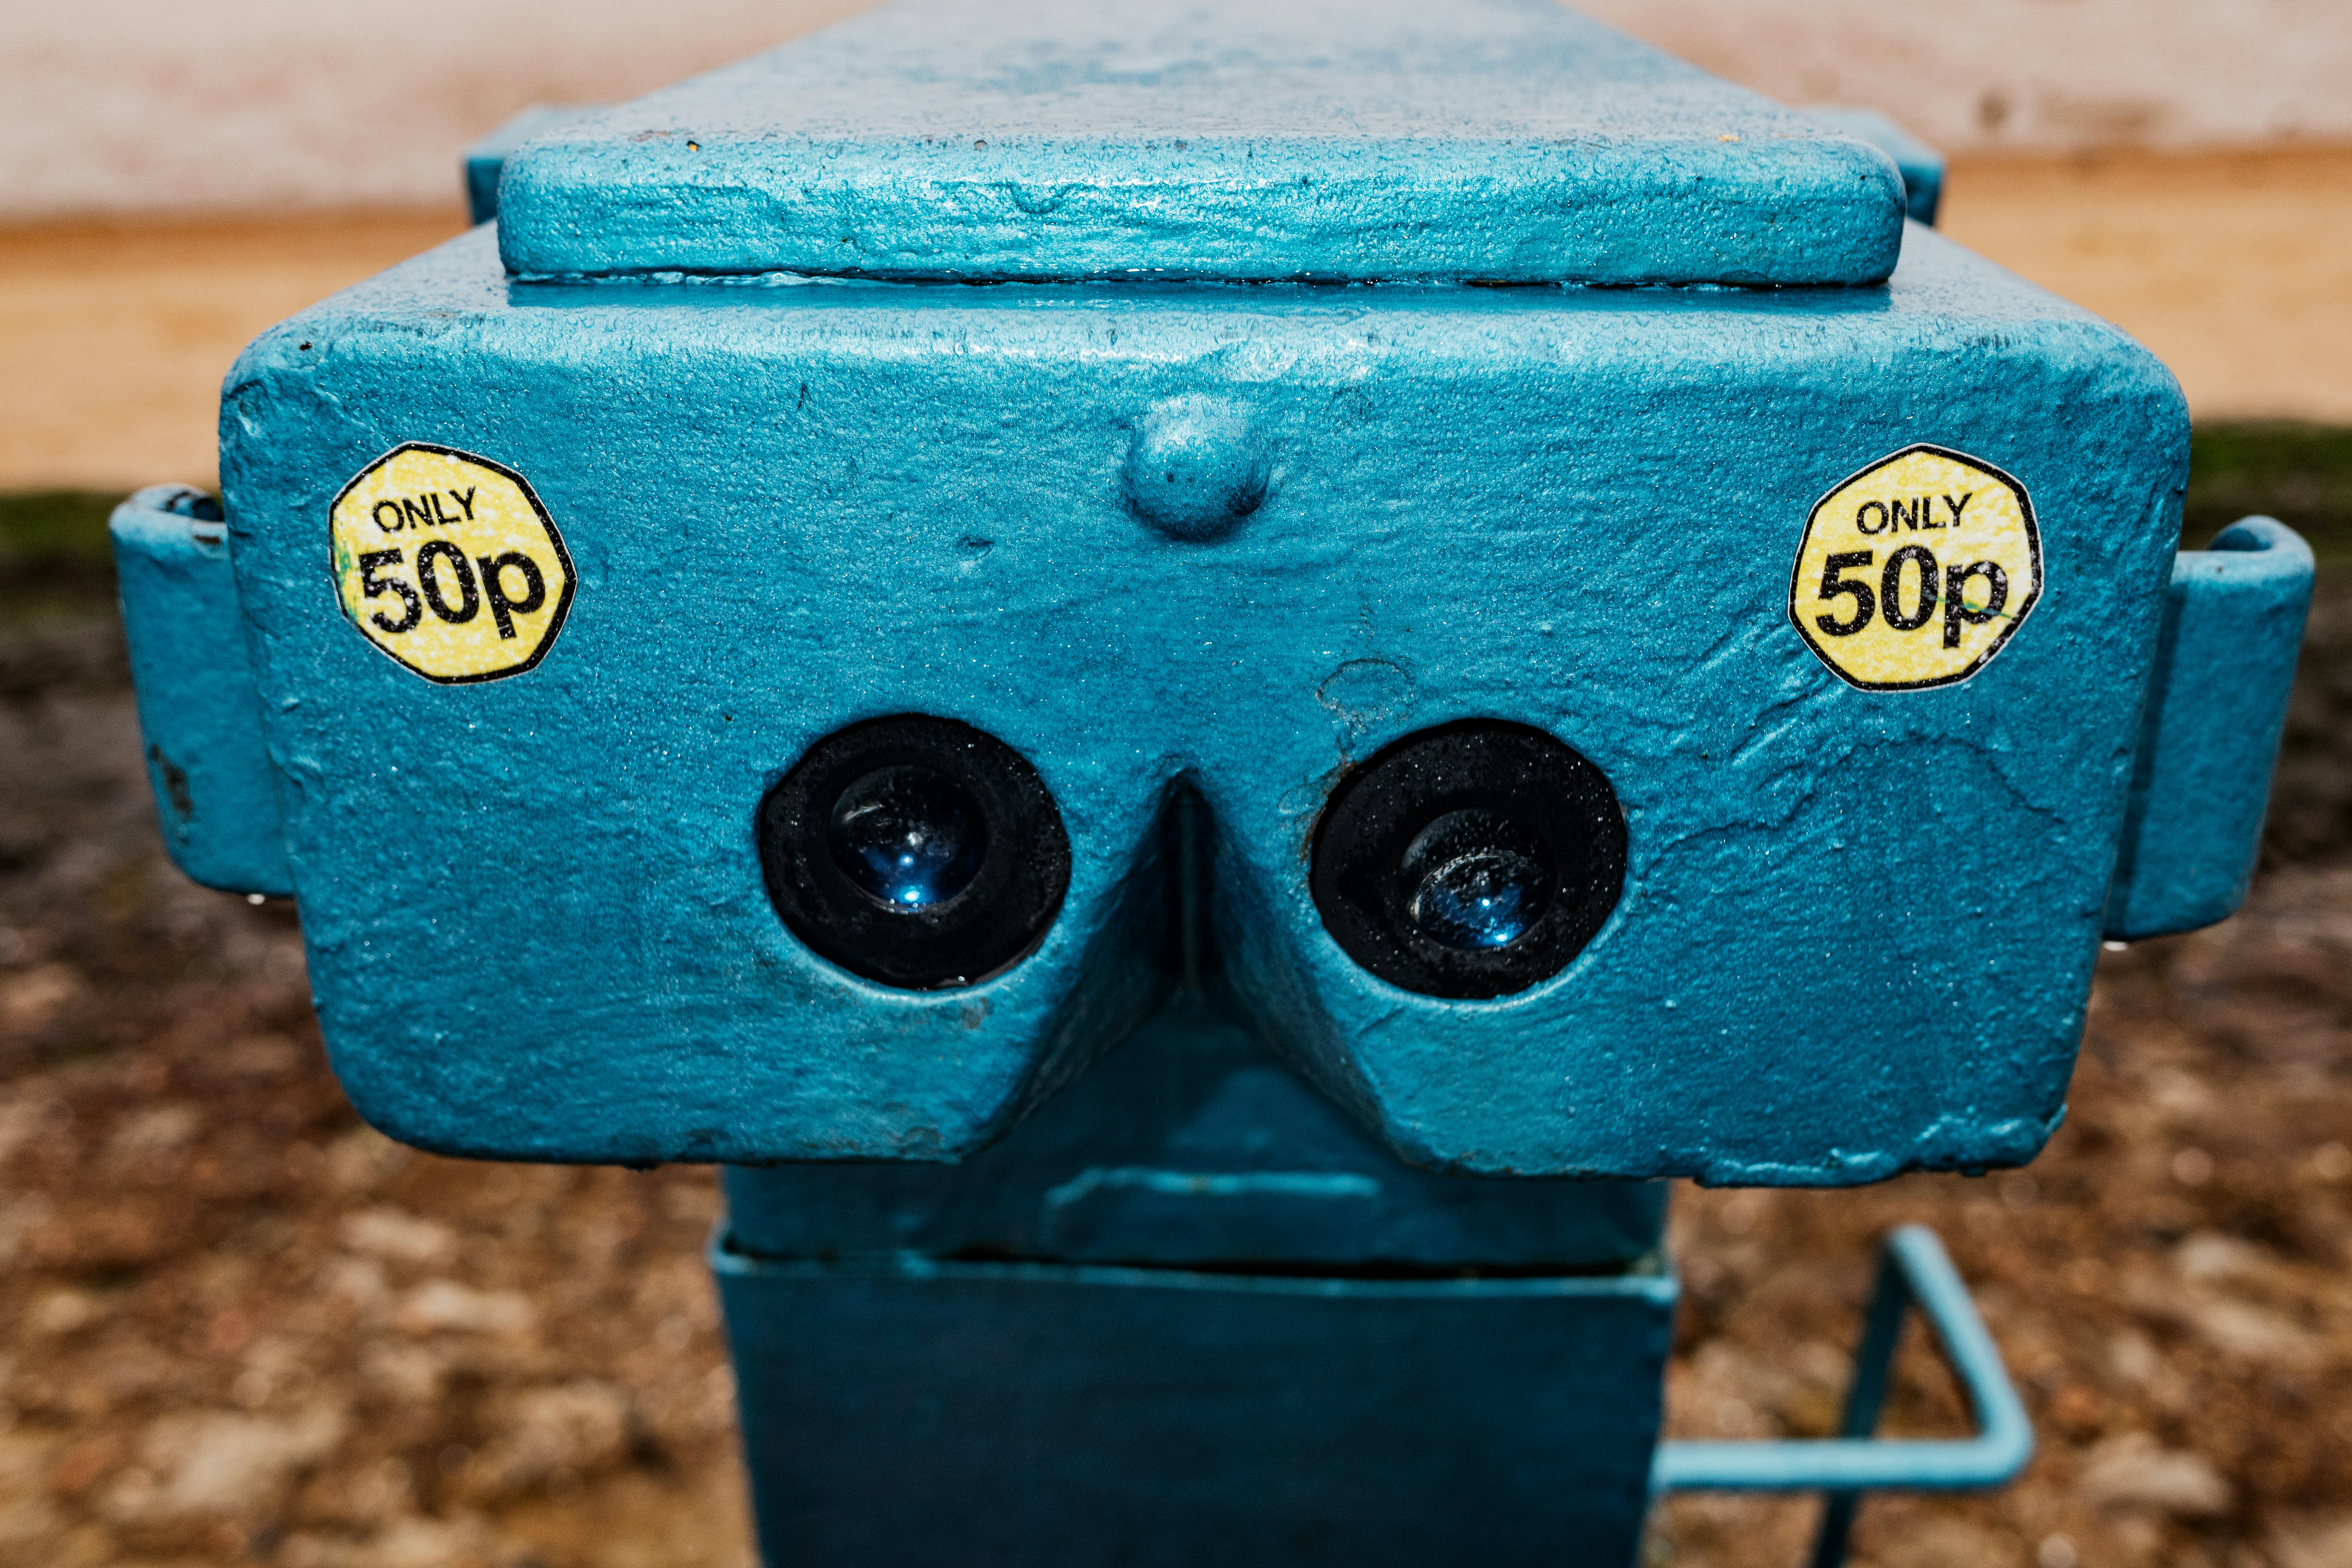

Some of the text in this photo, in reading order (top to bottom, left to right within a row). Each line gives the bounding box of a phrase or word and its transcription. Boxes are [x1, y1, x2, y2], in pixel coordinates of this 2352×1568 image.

[372, 485, 475, 533] ONLY
[1857, 492, 1973, 535] ONLY
[359, 540, 546, 640] 50p
[1815, 545, 2008, 649] 50p
